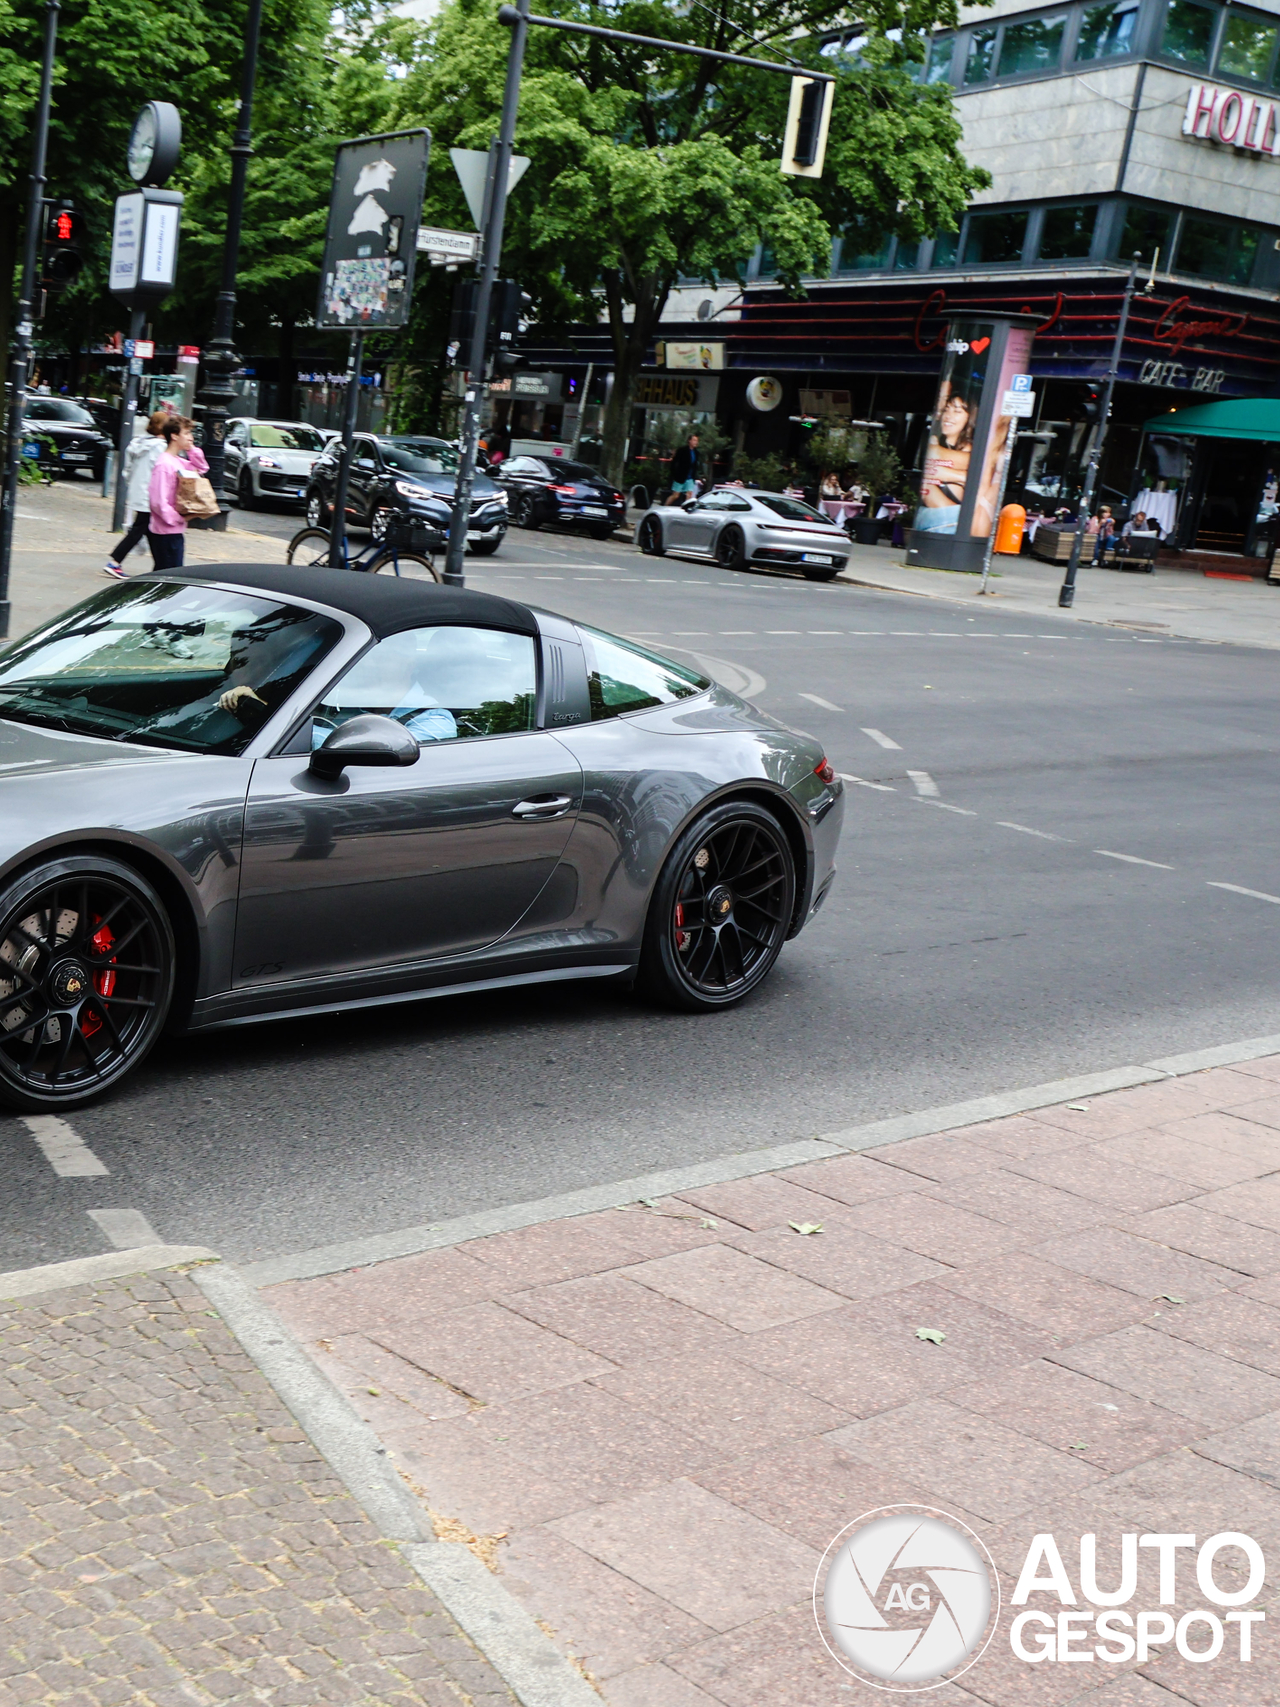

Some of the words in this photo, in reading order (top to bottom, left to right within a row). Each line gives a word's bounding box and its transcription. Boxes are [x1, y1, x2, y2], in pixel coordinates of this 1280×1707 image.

[1191, 366, 1225, 393] BAR
[634, 378, 699, 406] HHAUS
[551, 711, 582, 723] Targa
[239, 960, 287, 979] GTS
